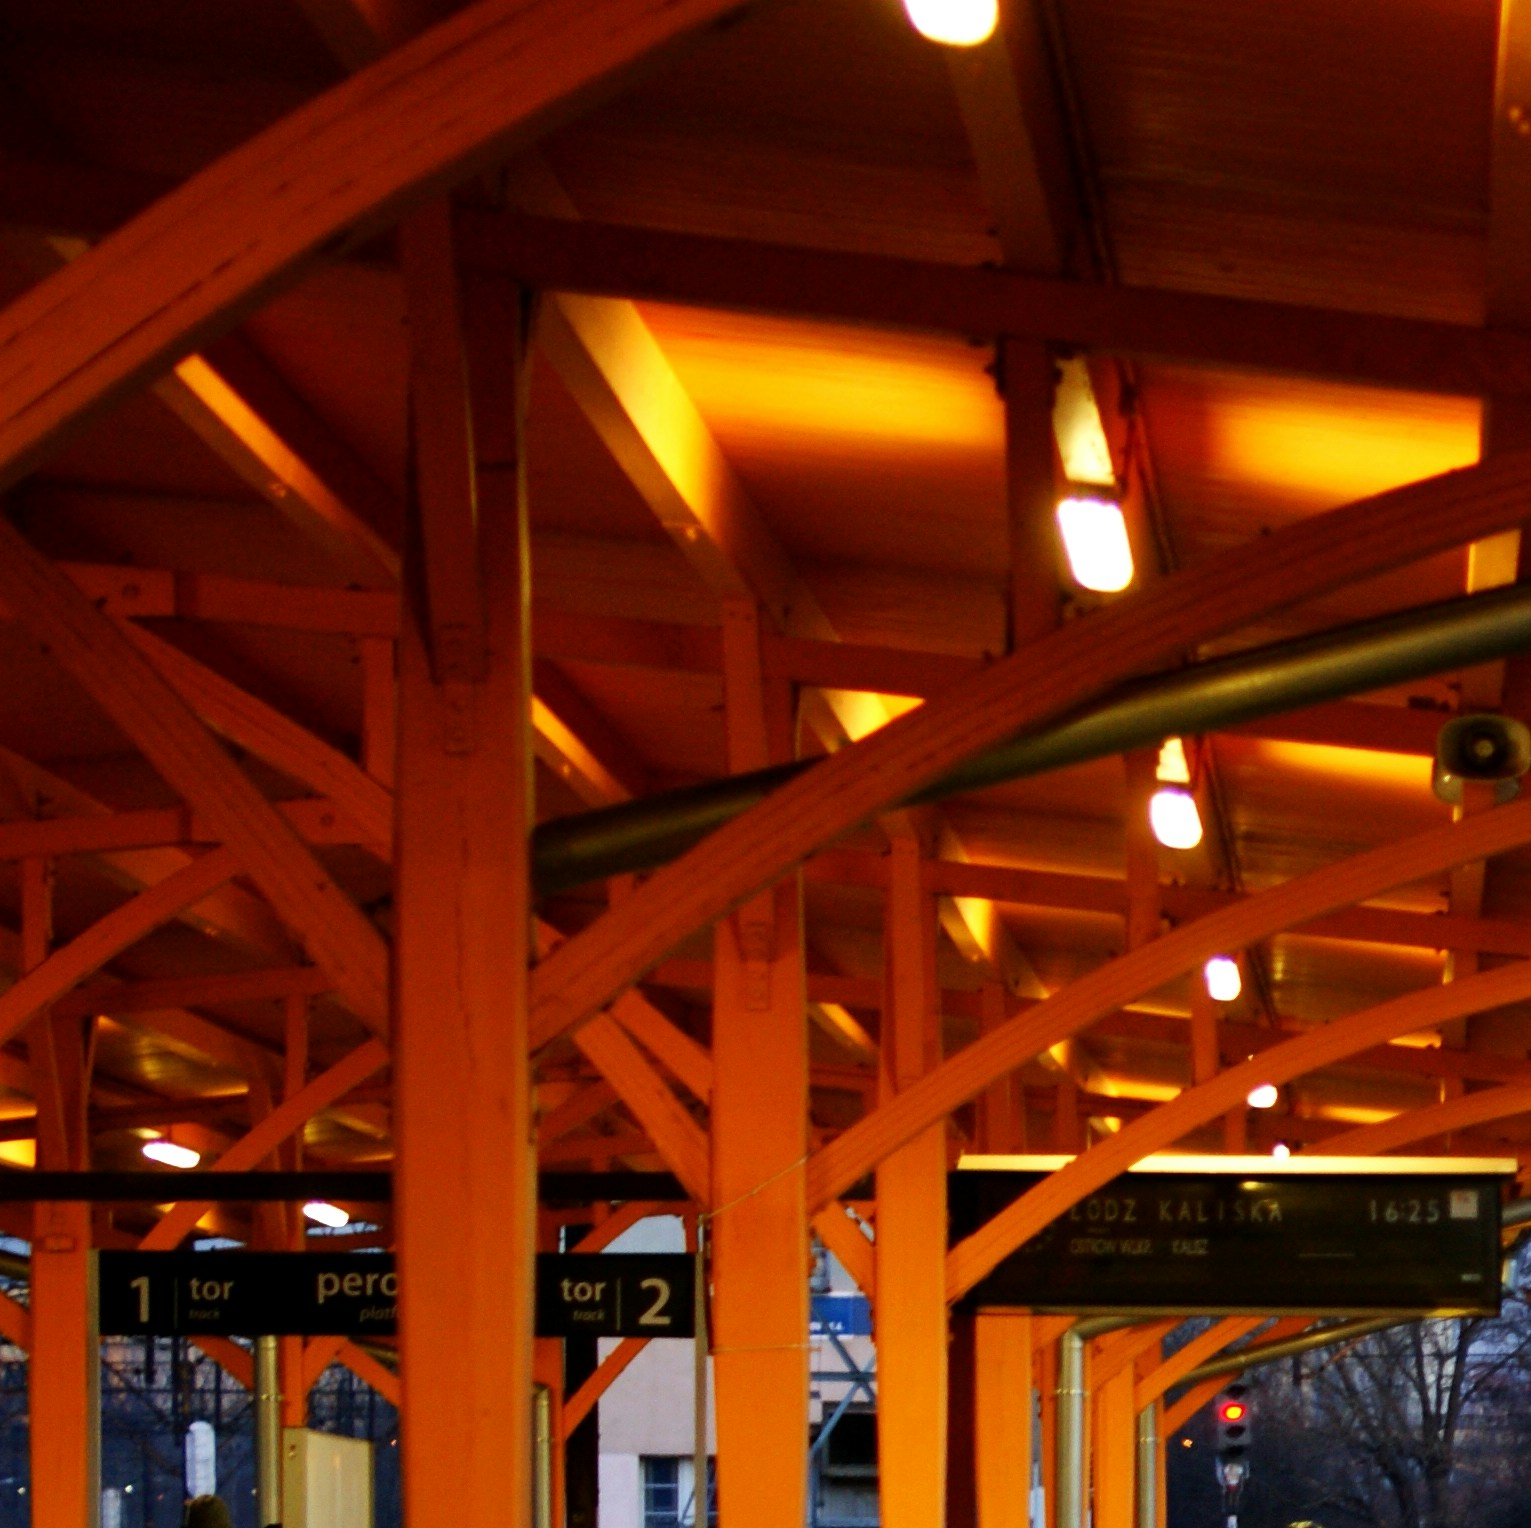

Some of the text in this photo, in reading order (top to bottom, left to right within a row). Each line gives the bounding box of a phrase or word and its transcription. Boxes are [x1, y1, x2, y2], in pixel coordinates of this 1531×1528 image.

[129, 1275, 151, 1323] 1
[188, 1276, 235, 1302] tor
[560, 1277, 607, 1302] tor
[637, 1277, 672, 1326] 2
[188, 1307, 221, 1321] track
[573, 1308, 605, 1321] track
